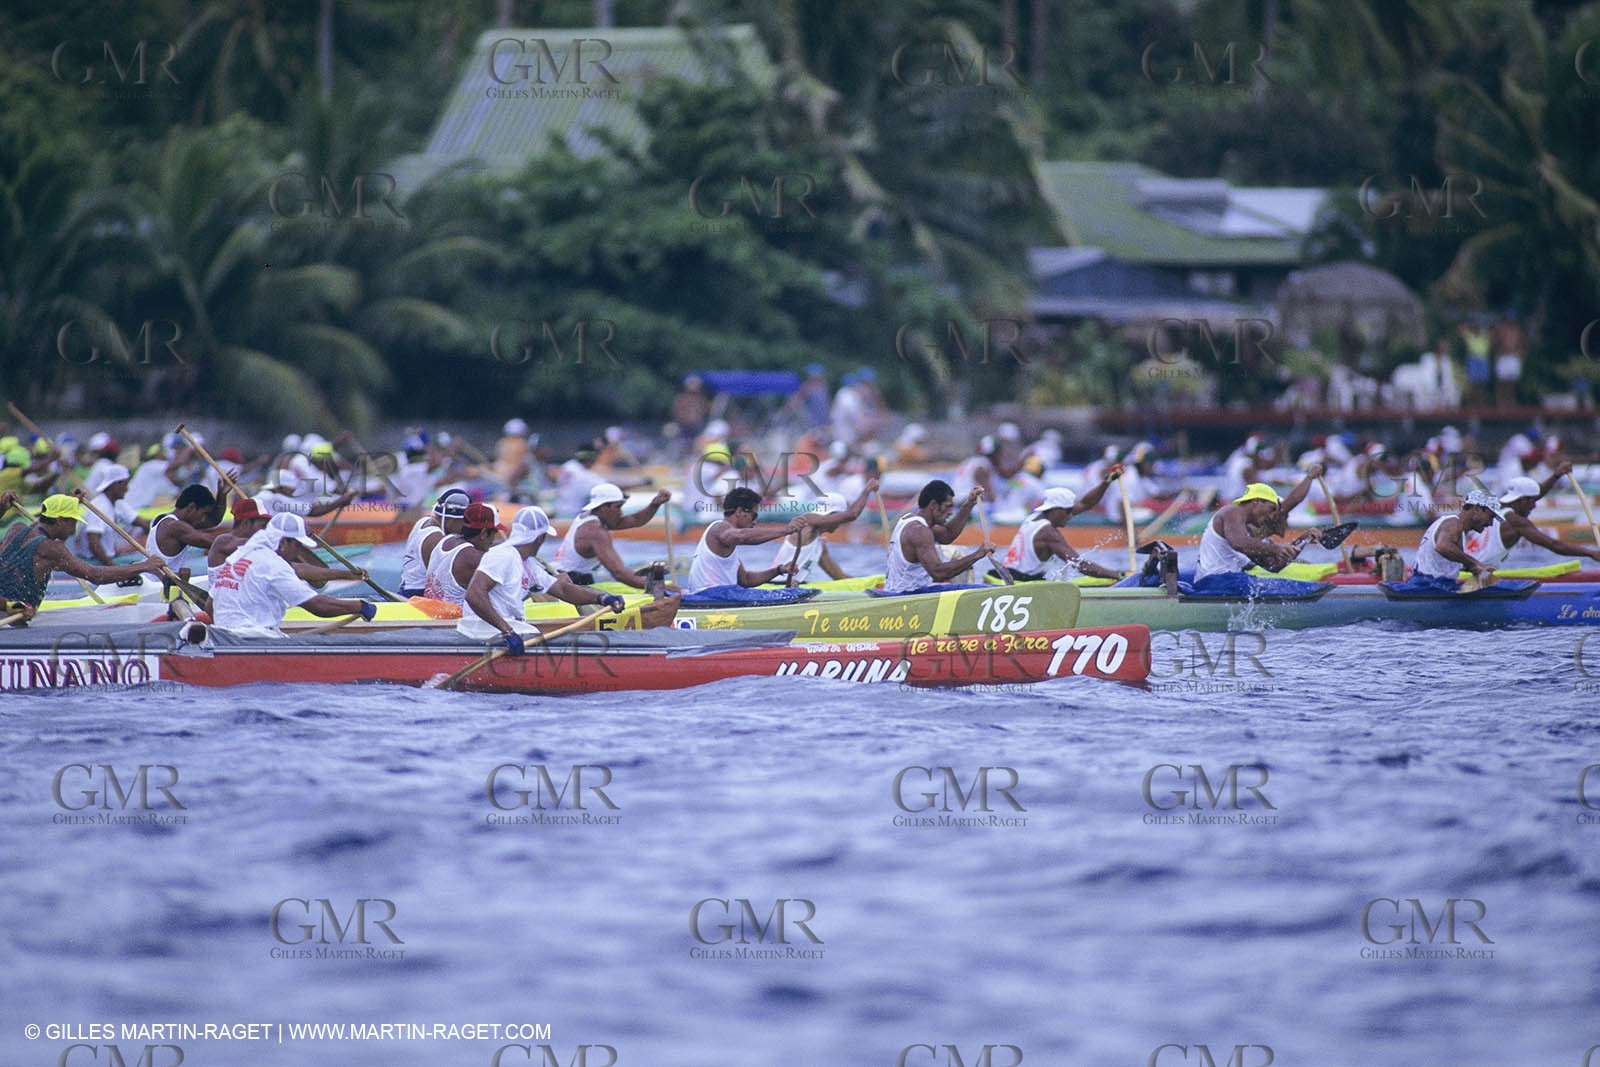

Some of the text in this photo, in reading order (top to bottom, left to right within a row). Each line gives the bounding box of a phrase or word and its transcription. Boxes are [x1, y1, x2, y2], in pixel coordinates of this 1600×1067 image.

[838, 615, 872, 632] ava
[977, 595, 1033, 632] 185
[909, 638, 928, 655] Te
[1046, 633, 1129, 676] 170
[0, 658, 150, 690] INANO
